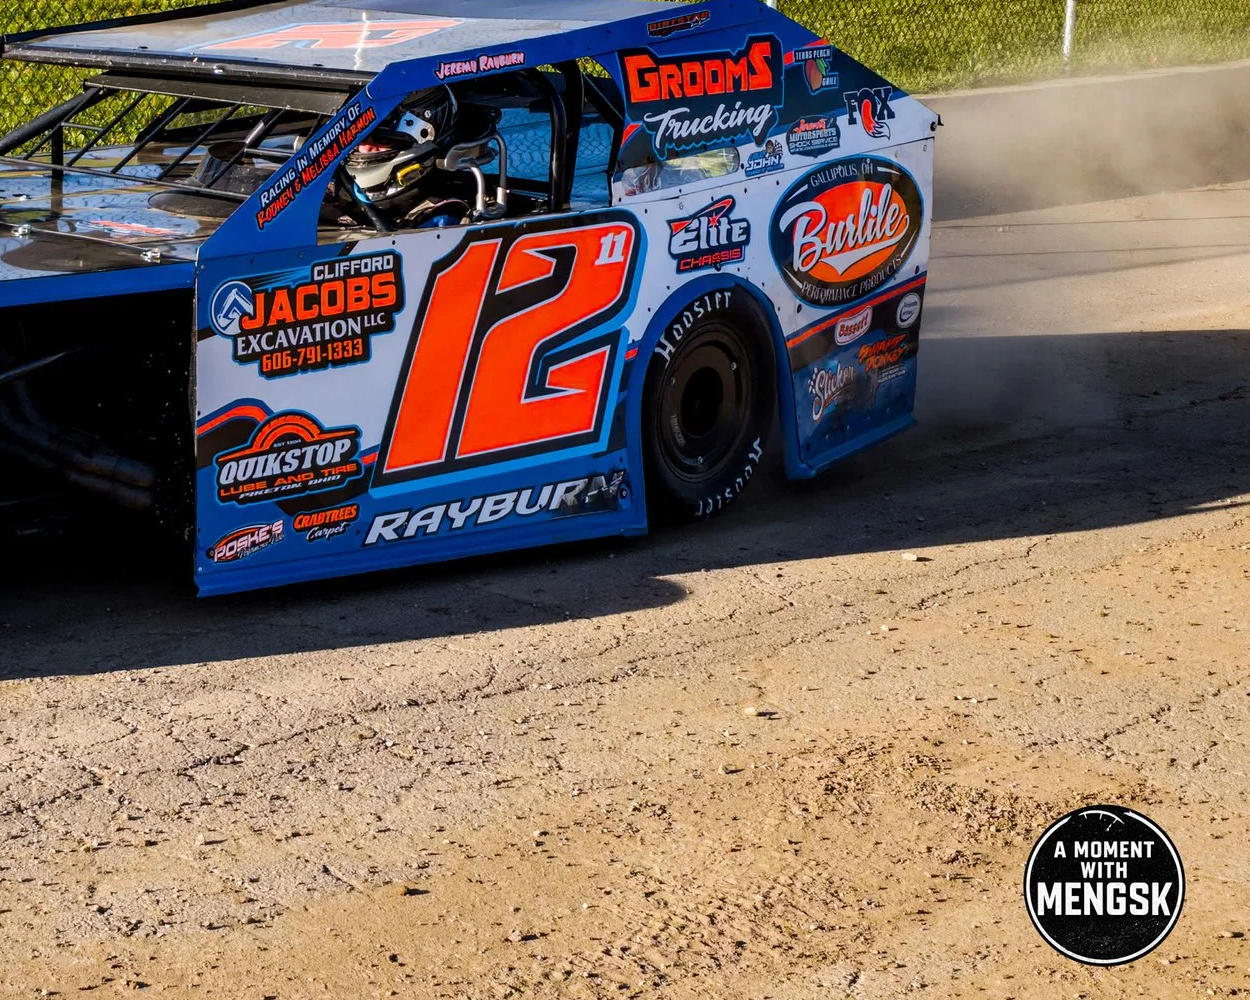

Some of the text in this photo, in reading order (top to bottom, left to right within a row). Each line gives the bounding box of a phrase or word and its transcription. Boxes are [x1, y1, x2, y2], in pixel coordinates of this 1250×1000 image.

[623, 42, 773, 103] GROOMS
[644, 100, 774, 150] Trucking
[843, 86, 896, 138] FOX
[301, 147, 340, 189] MELISSA
[338, 107, 376, 149] HARMON
[745, 154, 780, 171] JOHN
[860, 160, 874, 176] OH
[595, 230, 628, 266] 11
[670, 212, 748, 252] Elite
[779, 183, 910, 273] Burlile
[313, 254, 395, 282] CLIFFORD
[679, 247, 742, 271] CHASSIS
[801, 256, 903, 304] PERFORMANCE PRODUCTS
[242, 272, 397, 331] JACOBS
[236, 312, 387, 357] EXCAVATION LLC
[261, 337, 364, 374] 606-791-1333
[382, 221, 636, 475] 12
[219, 438, 352, 485] QUIKSTOP
[220, 462, 358, 497] LUBE AND TIRE
[307, 474, 342, 486] OHIO
[293, 504, 358, 530] CRABTREES
[306, 521, 349, 541] Carpet
[214, 519, 284, 563] POSKE'S
